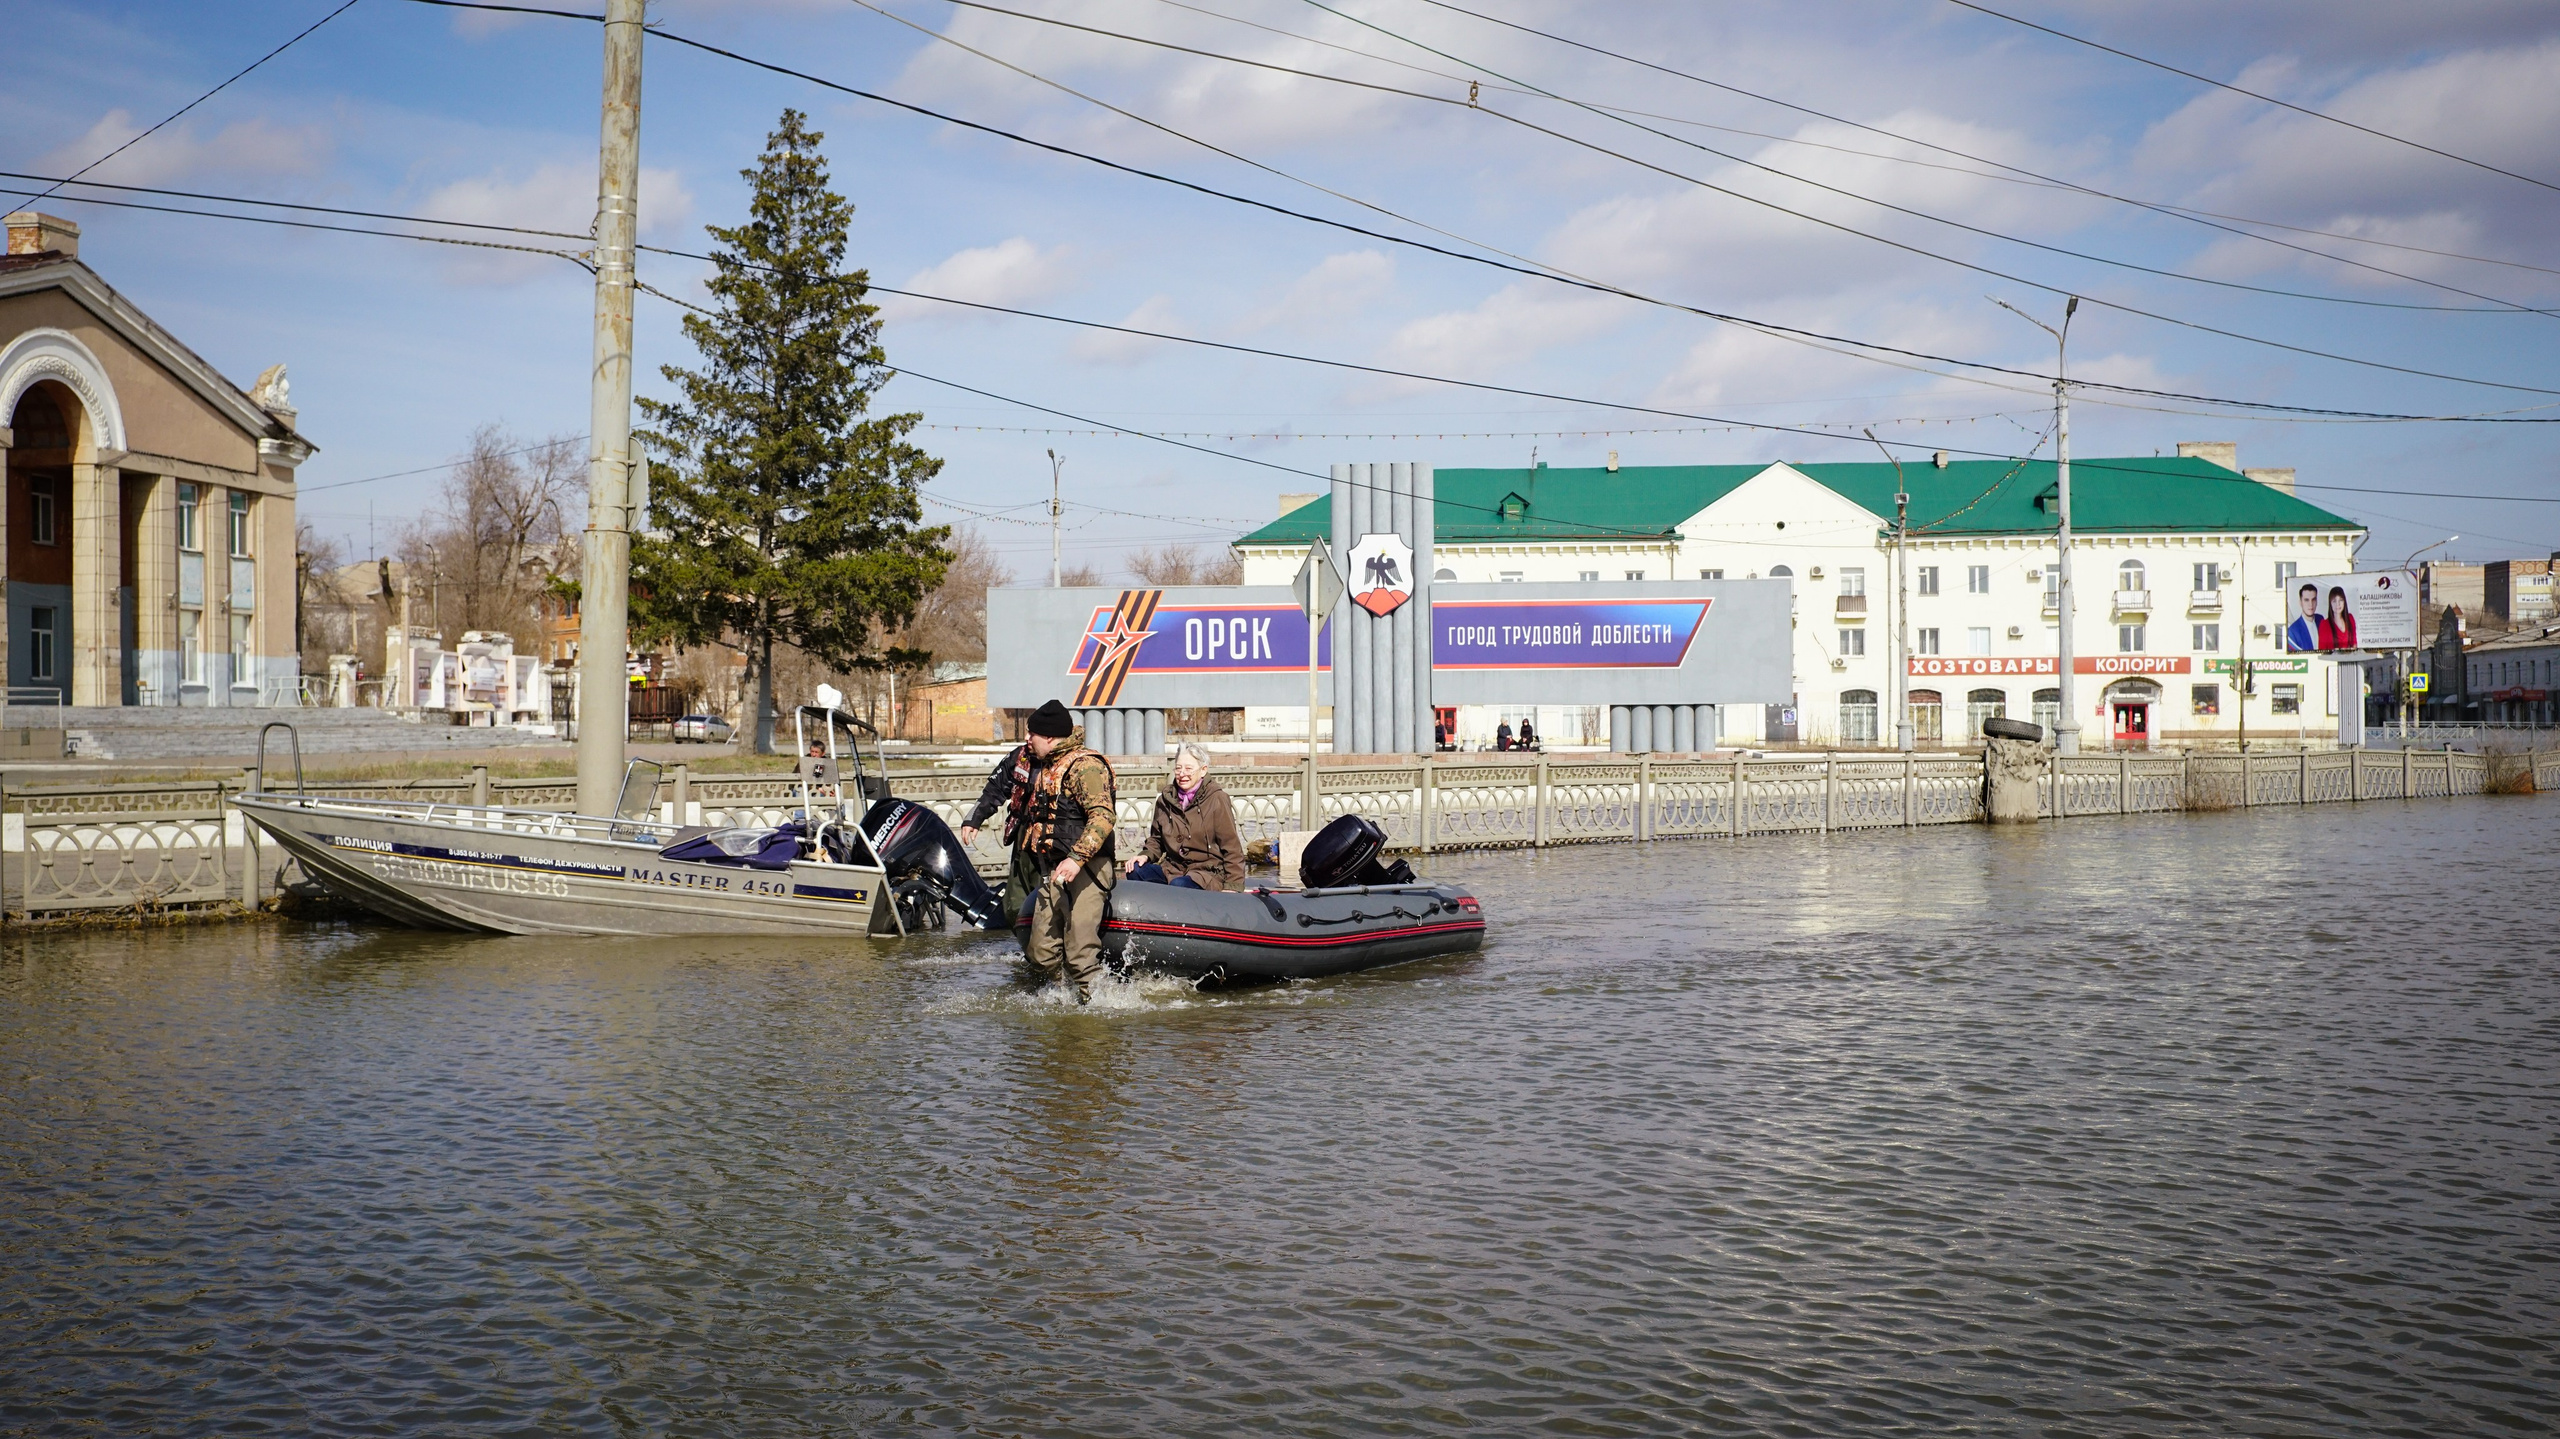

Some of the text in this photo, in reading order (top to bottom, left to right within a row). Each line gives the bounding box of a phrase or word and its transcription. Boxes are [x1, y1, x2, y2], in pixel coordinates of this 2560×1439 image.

[2359, 593, 2403, 601] КАЛАШНИКОВЫ
[1185, 617, 1272, 660] ОРСК
[1448, 622, 1672, 647] ГОРОД ТРУДОВОЙ ДОБЛЕСТИ
[1911, 659, 2054, 674] ХОЗТОВАРЫ
[2095, 658, 2179, 672] КОЛОРИТ
[870, 802, 907, 850] MERCURY
[334, 836, 393, 852] ПОЛИЦИЯ
[518, 856, 622, 872] ТЕЛЕФОН ДЕЖУРНОЙ ЧАСТИ
[1343, 842, 1367, 868] TOHATSU
[631, 868, 786, 897] MASTER 450
